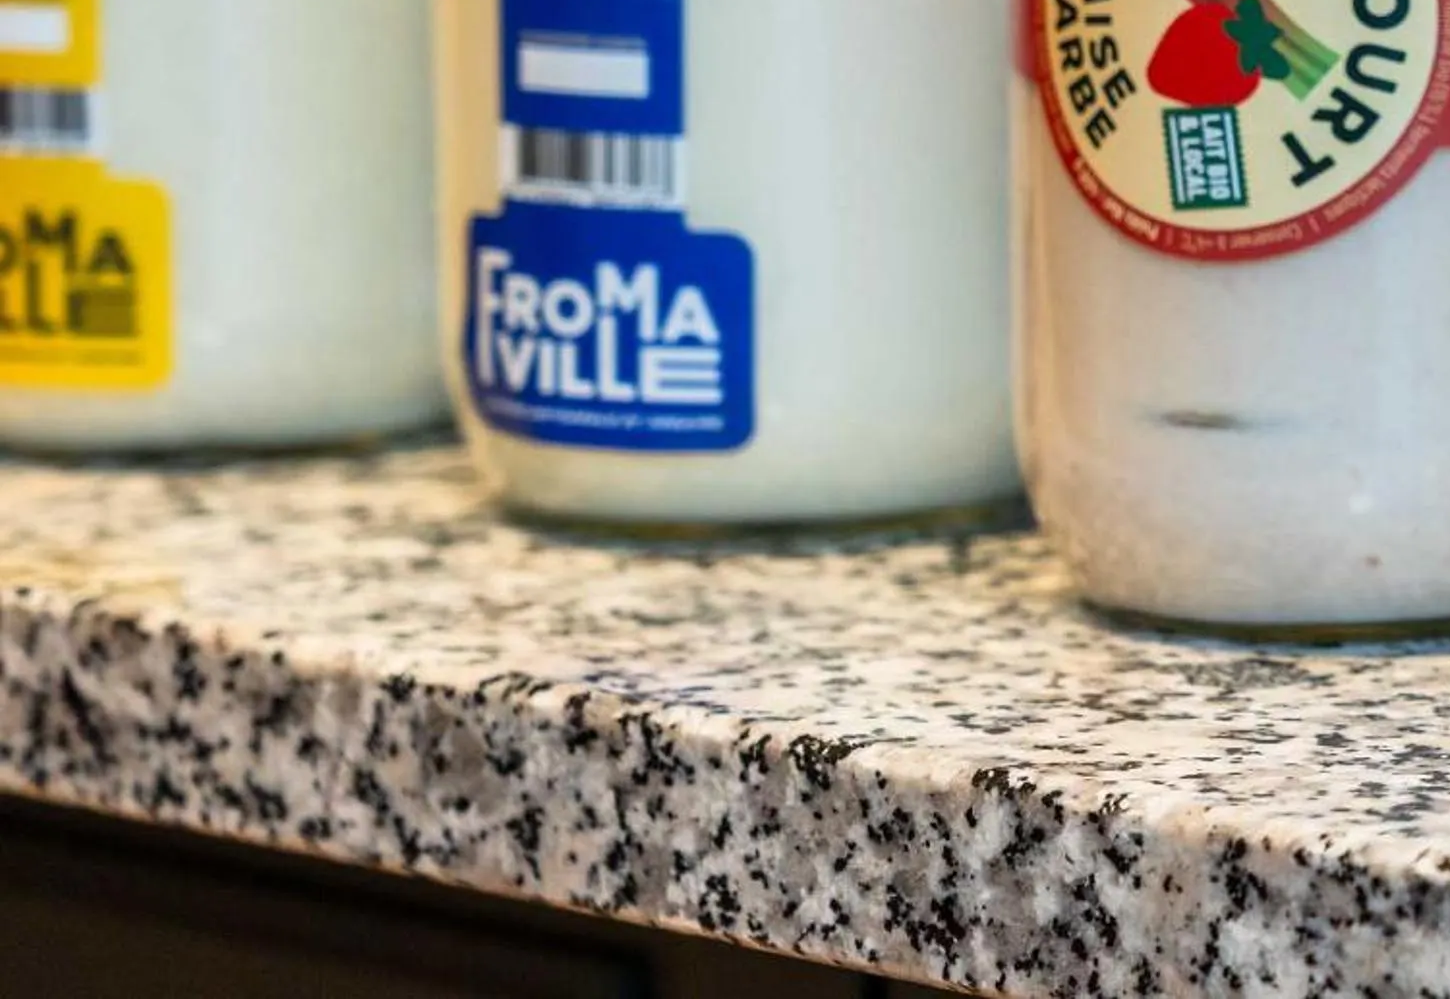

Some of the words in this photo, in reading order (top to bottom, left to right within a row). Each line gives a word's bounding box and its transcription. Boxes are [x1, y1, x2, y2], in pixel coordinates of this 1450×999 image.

[1201, 113, 1226, 160] LAIT
[1182, 137, 1207, 203] LOCAL
[1207, 163, 1231, 200] BIO
[475, 247, 721, 386] FROMA
[496, 314, 724, 404] VILLE
